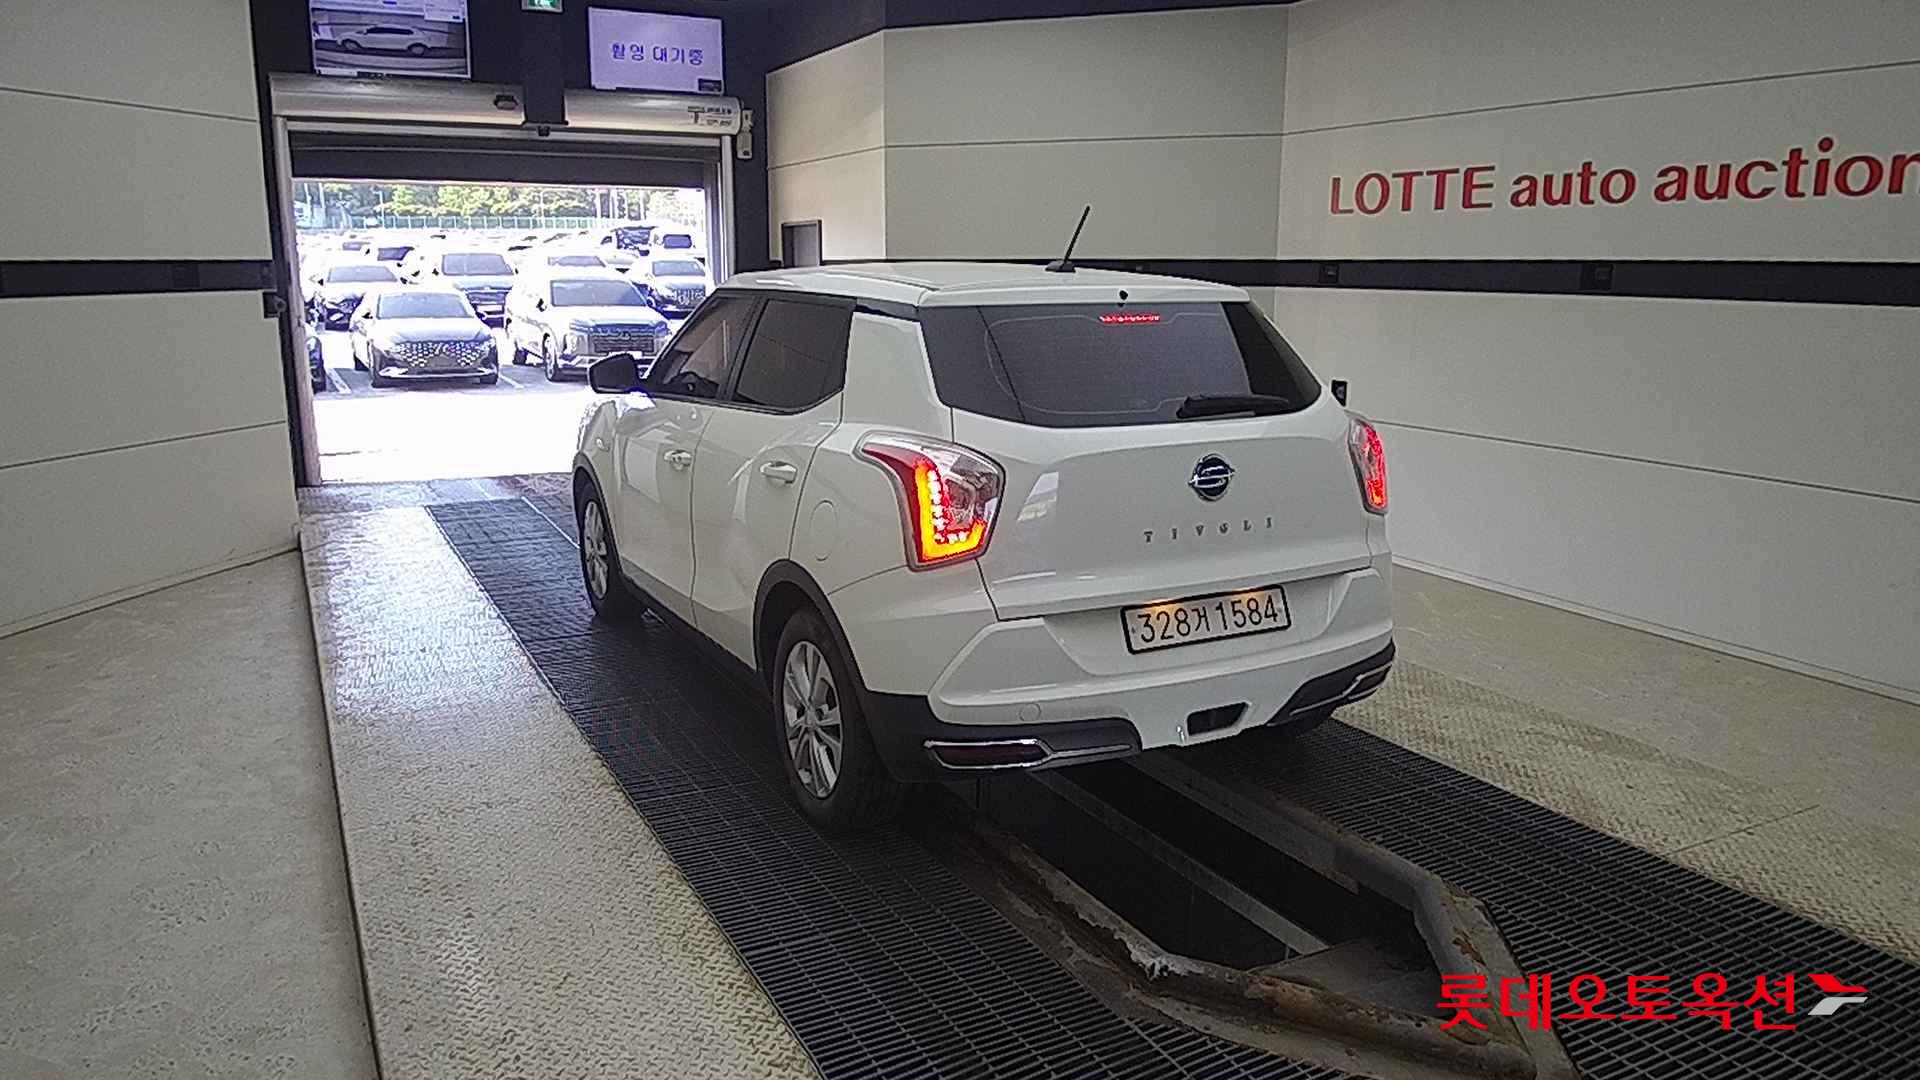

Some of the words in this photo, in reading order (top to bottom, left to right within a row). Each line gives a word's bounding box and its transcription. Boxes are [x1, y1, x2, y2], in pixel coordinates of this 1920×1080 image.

[652, 46, 704, 66] 대기중
[1329, 165, 1496, 215] LOTTE
[1510, 161, 1636, 207] auto
[1143, 516, 1273, 543] TIVOLI
[1216, 594, 1279, 630] 1584
